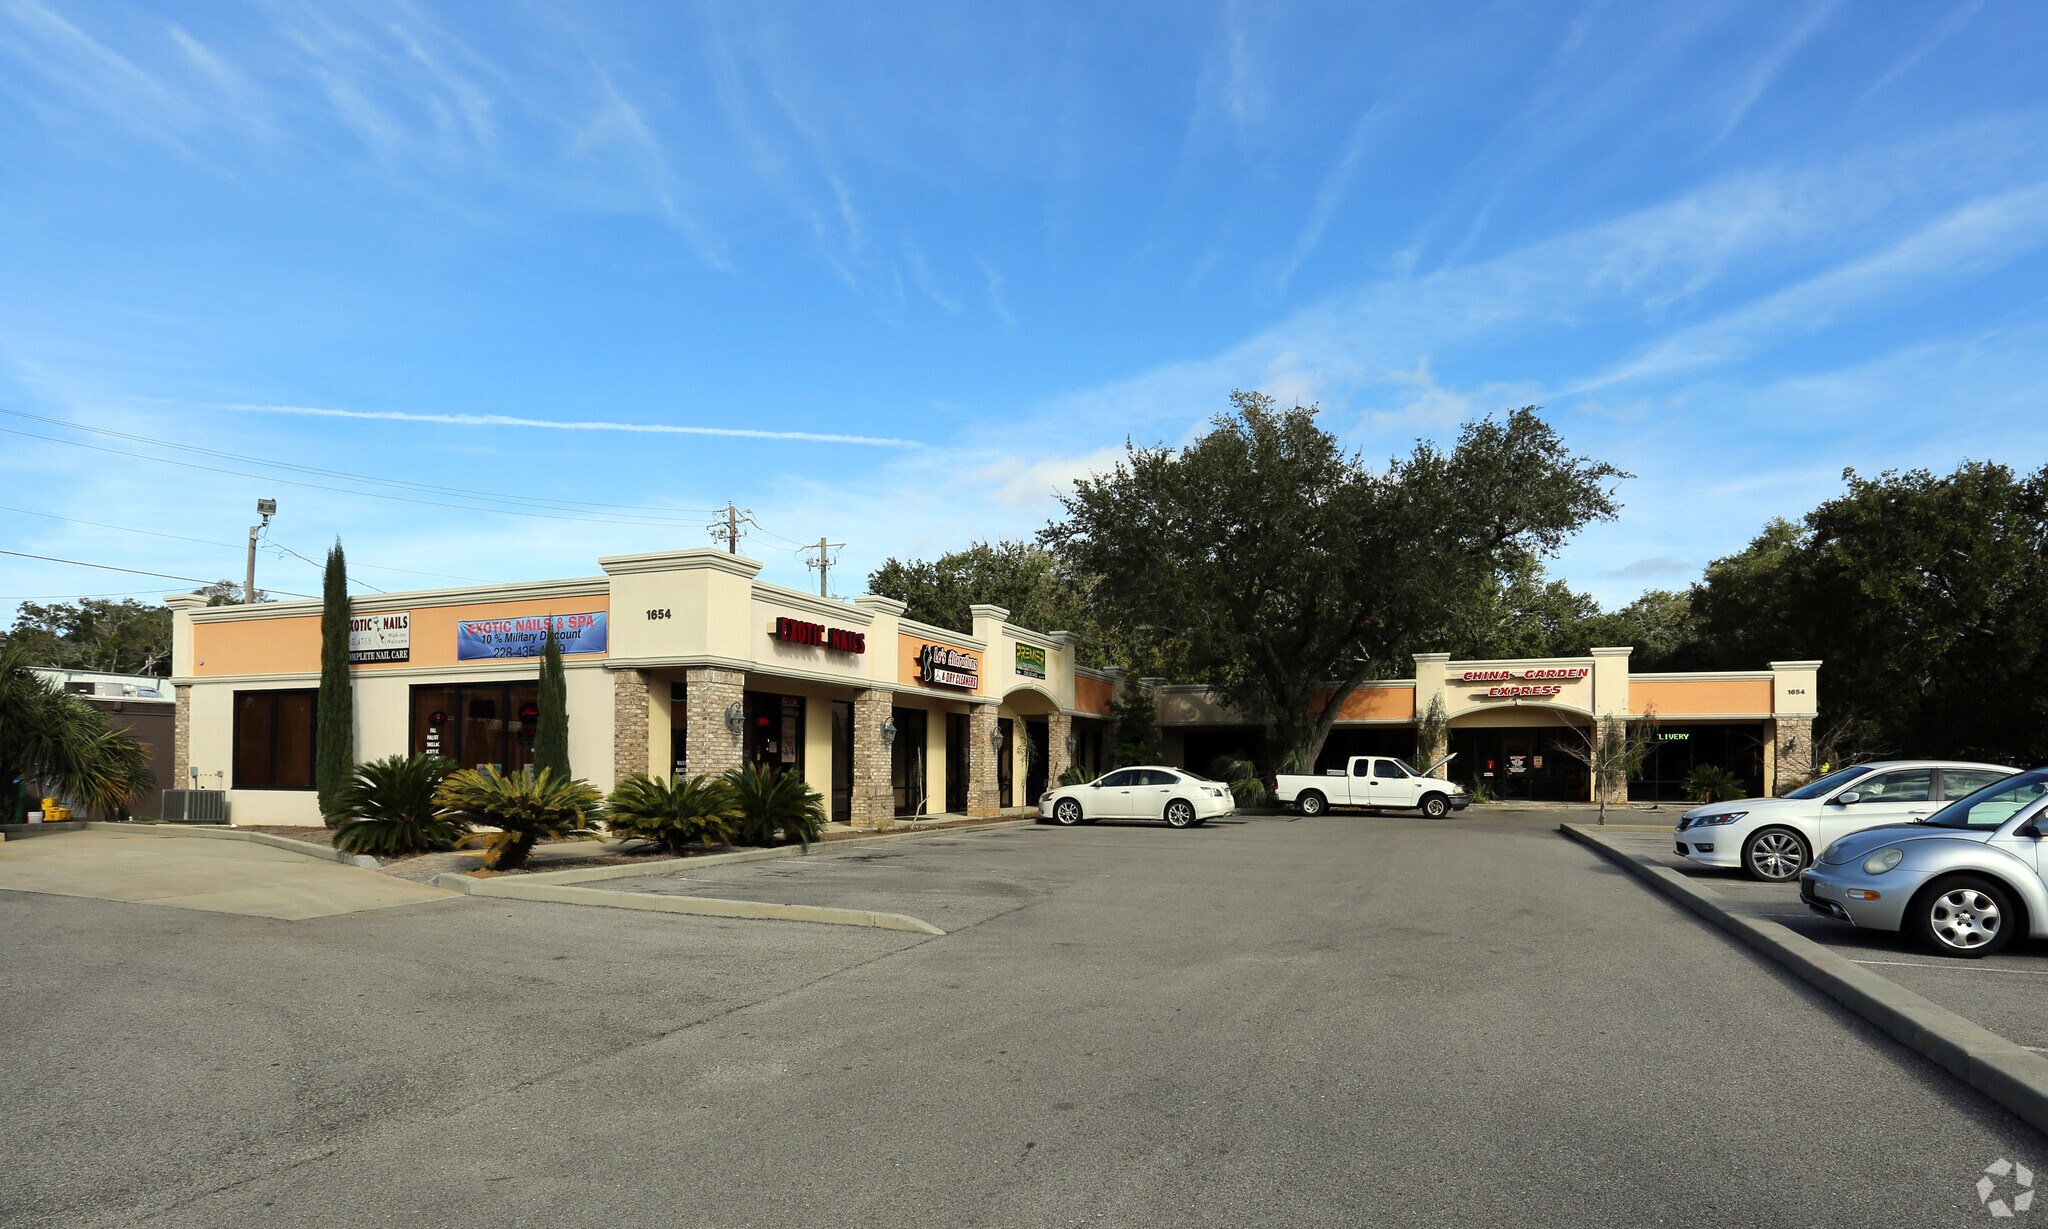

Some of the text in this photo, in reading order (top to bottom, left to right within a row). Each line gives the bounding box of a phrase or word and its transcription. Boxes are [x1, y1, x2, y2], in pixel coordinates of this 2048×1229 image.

[646, 609, 671, 620] 1654
[350, 616, 408, 632] XOTIC NAILS
[467, 615, 595, 635] EXOTIC NAILS & SPA
[481, 629, 581, 645] 10 % Military Dcount
[776, 617, 866, 654] EXOTIC NAILS
[350, 650, 408, 661] MPLETE NAIL CARE
[493, 643, 566, 659] 228-435-49
[1017, 645, 1044, 665] PREMIER
[946, 672, 956, 683] DRY
[955, 674, 977, 688] CLEANERS
[1463, 668, 1589, 681] CHINA GARDEN
[1489, 685, 1562, 696] EXPRESS
